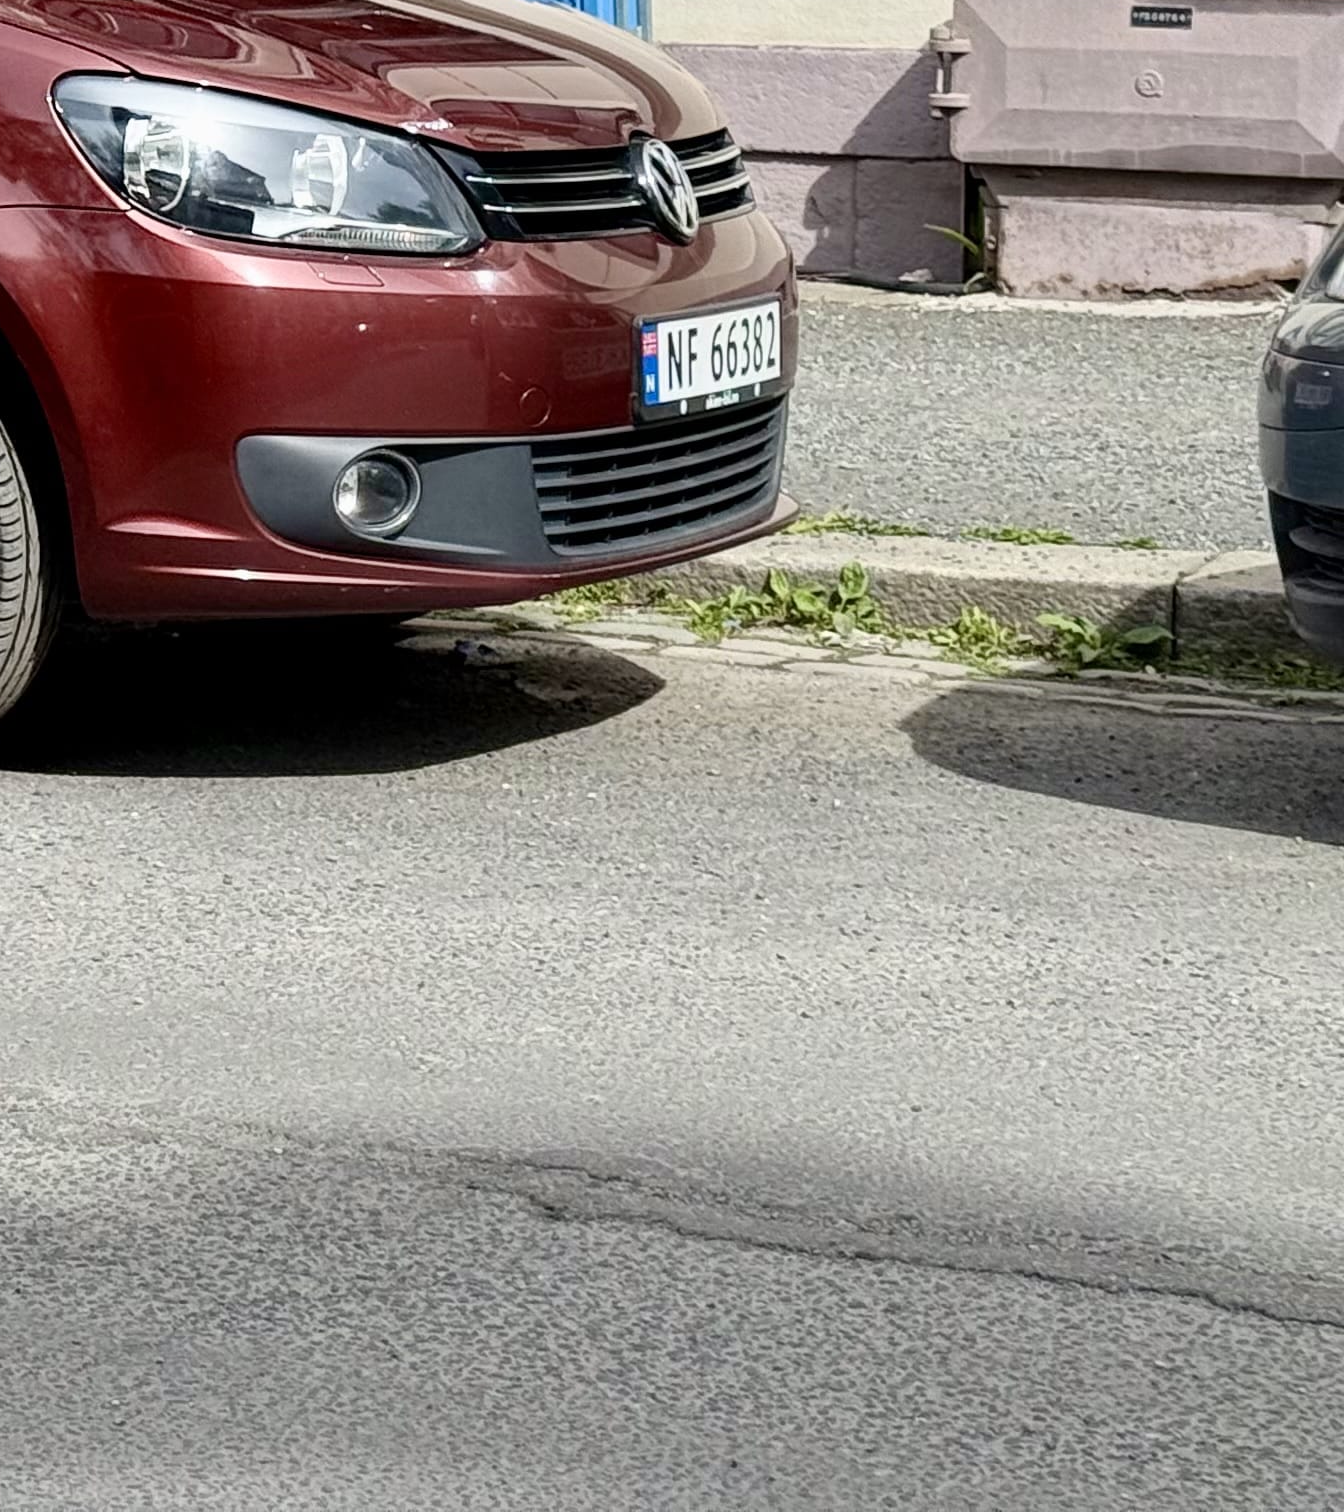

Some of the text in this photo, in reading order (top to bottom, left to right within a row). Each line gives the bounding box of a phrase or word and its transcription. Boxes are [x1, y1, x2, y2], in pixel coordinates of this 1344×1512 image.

[667, 311, 776, 391] NF 66382
[645, 373, 656, 393] N
